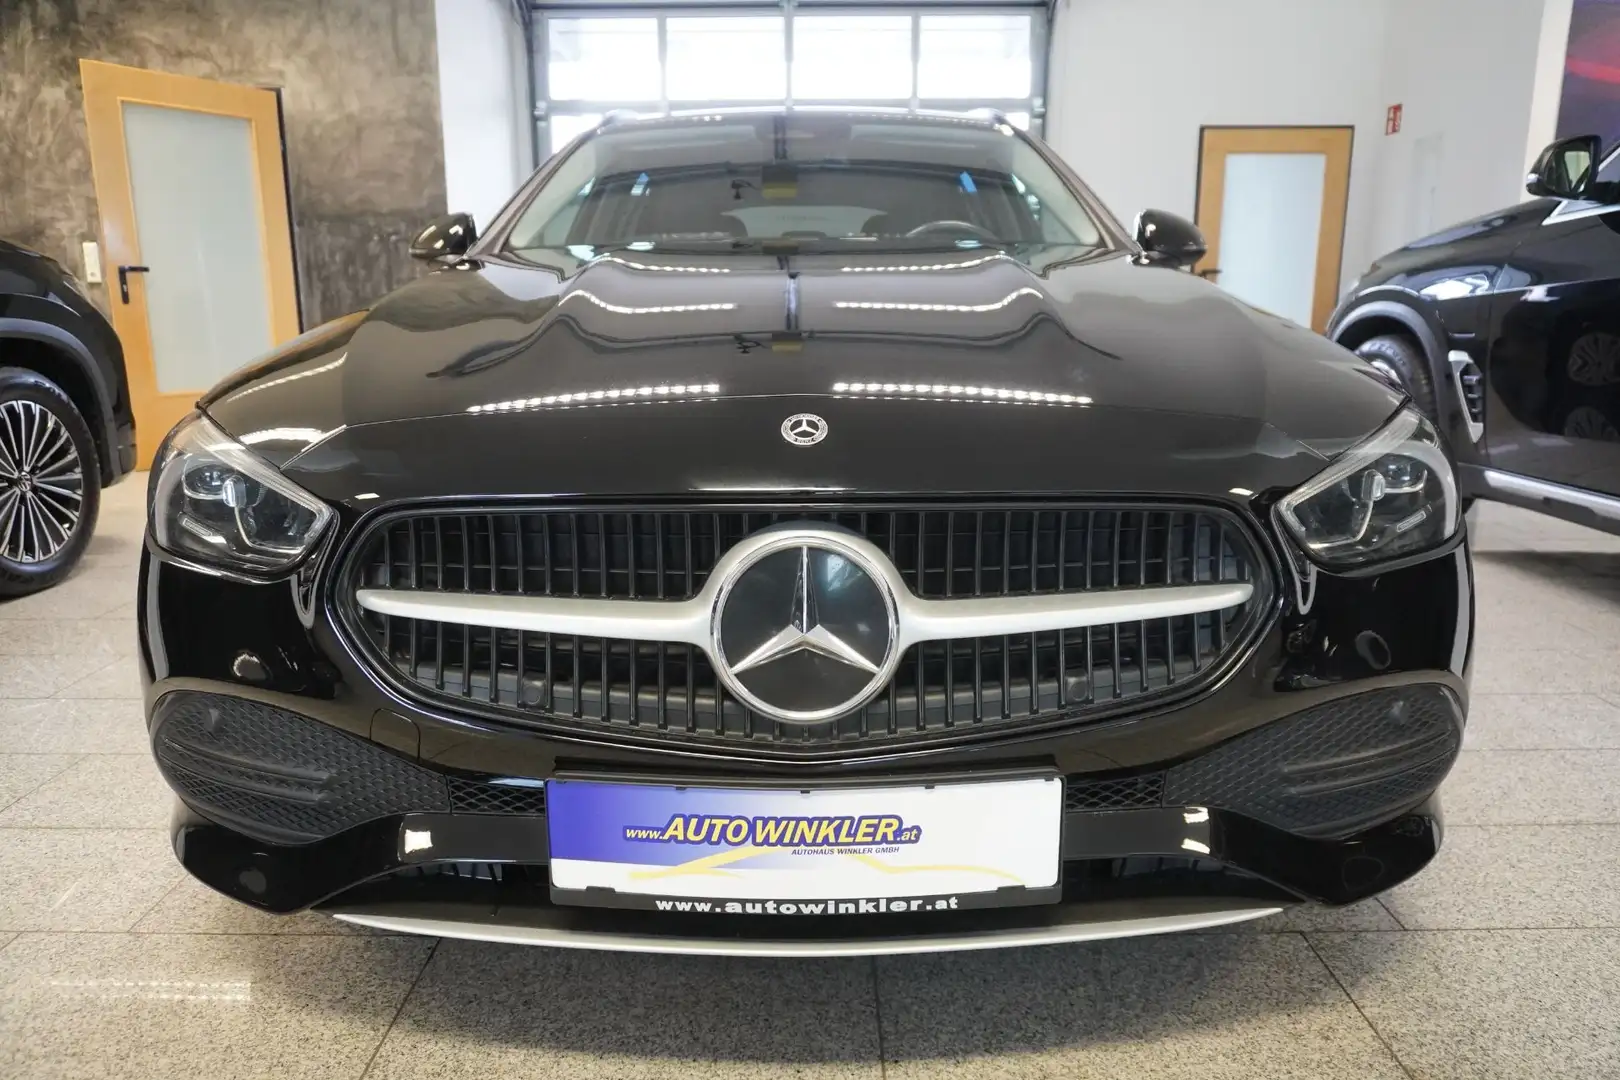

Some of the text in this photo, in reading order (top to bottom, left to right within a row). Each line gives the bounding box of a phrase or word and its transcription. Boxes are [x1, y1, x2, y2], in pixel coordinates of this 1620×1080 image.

[791, 846, 900, 856] AUTOHAUS WINKLER GMBH
[655, 896, 958, 915] www.autowinkler.at
